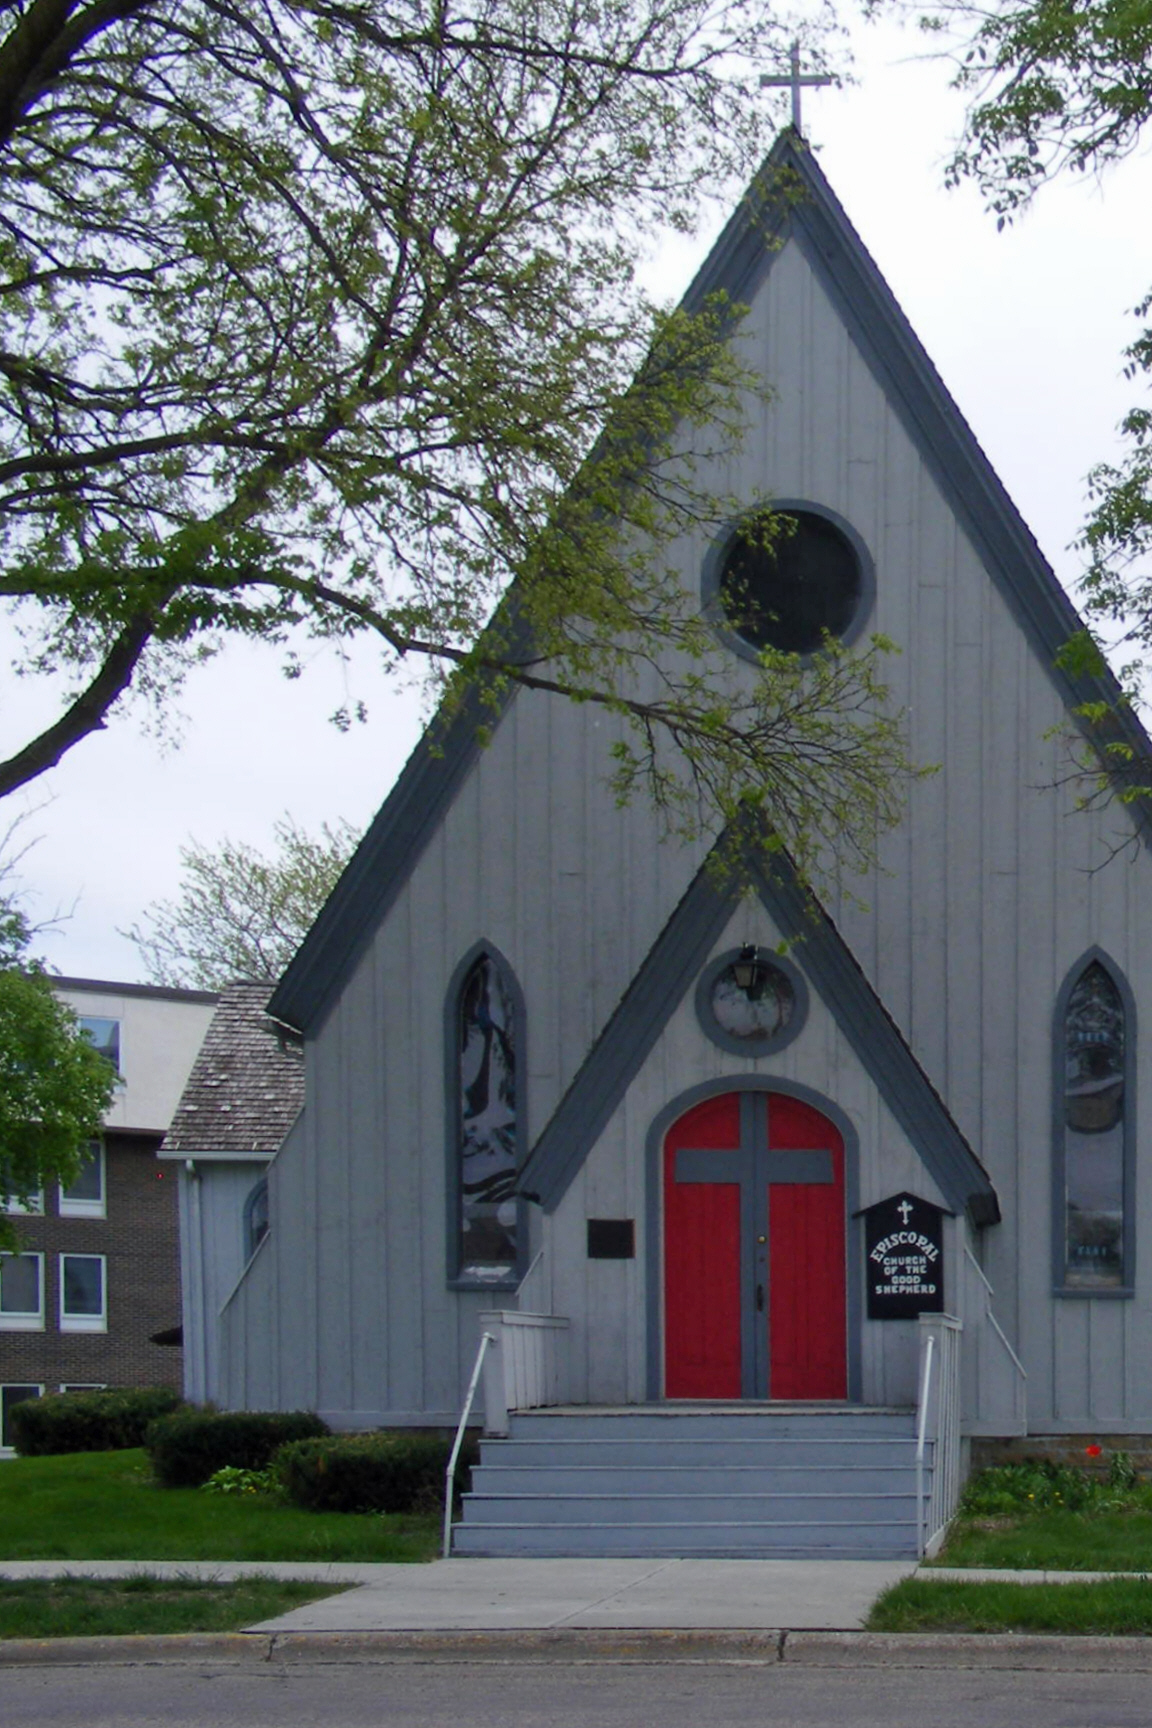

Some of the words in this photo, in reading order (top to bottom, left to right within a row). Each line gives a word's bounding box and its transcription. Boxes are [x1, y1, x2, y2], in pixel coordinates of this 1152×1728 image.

[870, 1231, 939, 1262] EPISCOPAL
[883, 1256, 926, 1266] CHURCH
[884, 1266, 898, 1275] OF
[905, 1265, 927, 1274] THE
[891, 1275, 921, 1284] GOOD
[875, 1285, 936, 1294] SHEPHERD
